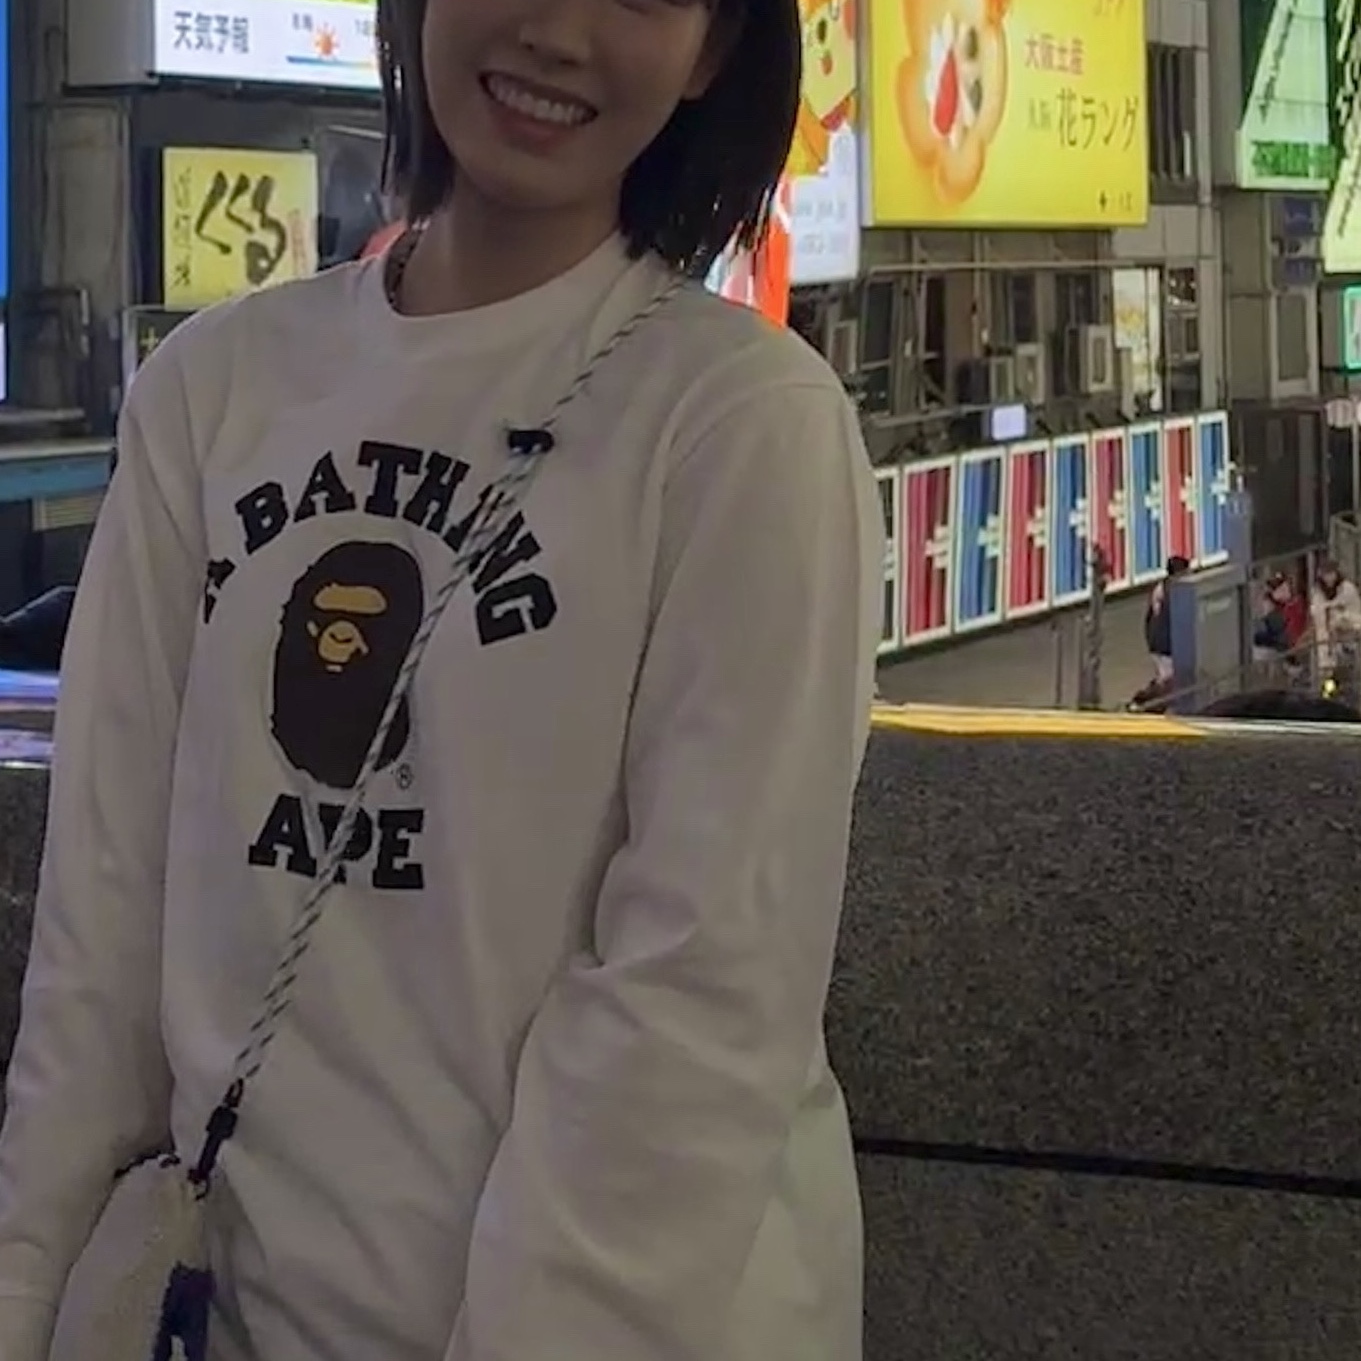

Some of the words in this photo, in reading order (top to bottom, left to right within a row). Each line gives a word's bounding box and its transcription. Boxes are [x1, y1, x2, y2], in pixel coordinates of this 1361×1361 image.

[174, 11, 249, 54] 天気予報
[247, 793, 426, 890] APE
